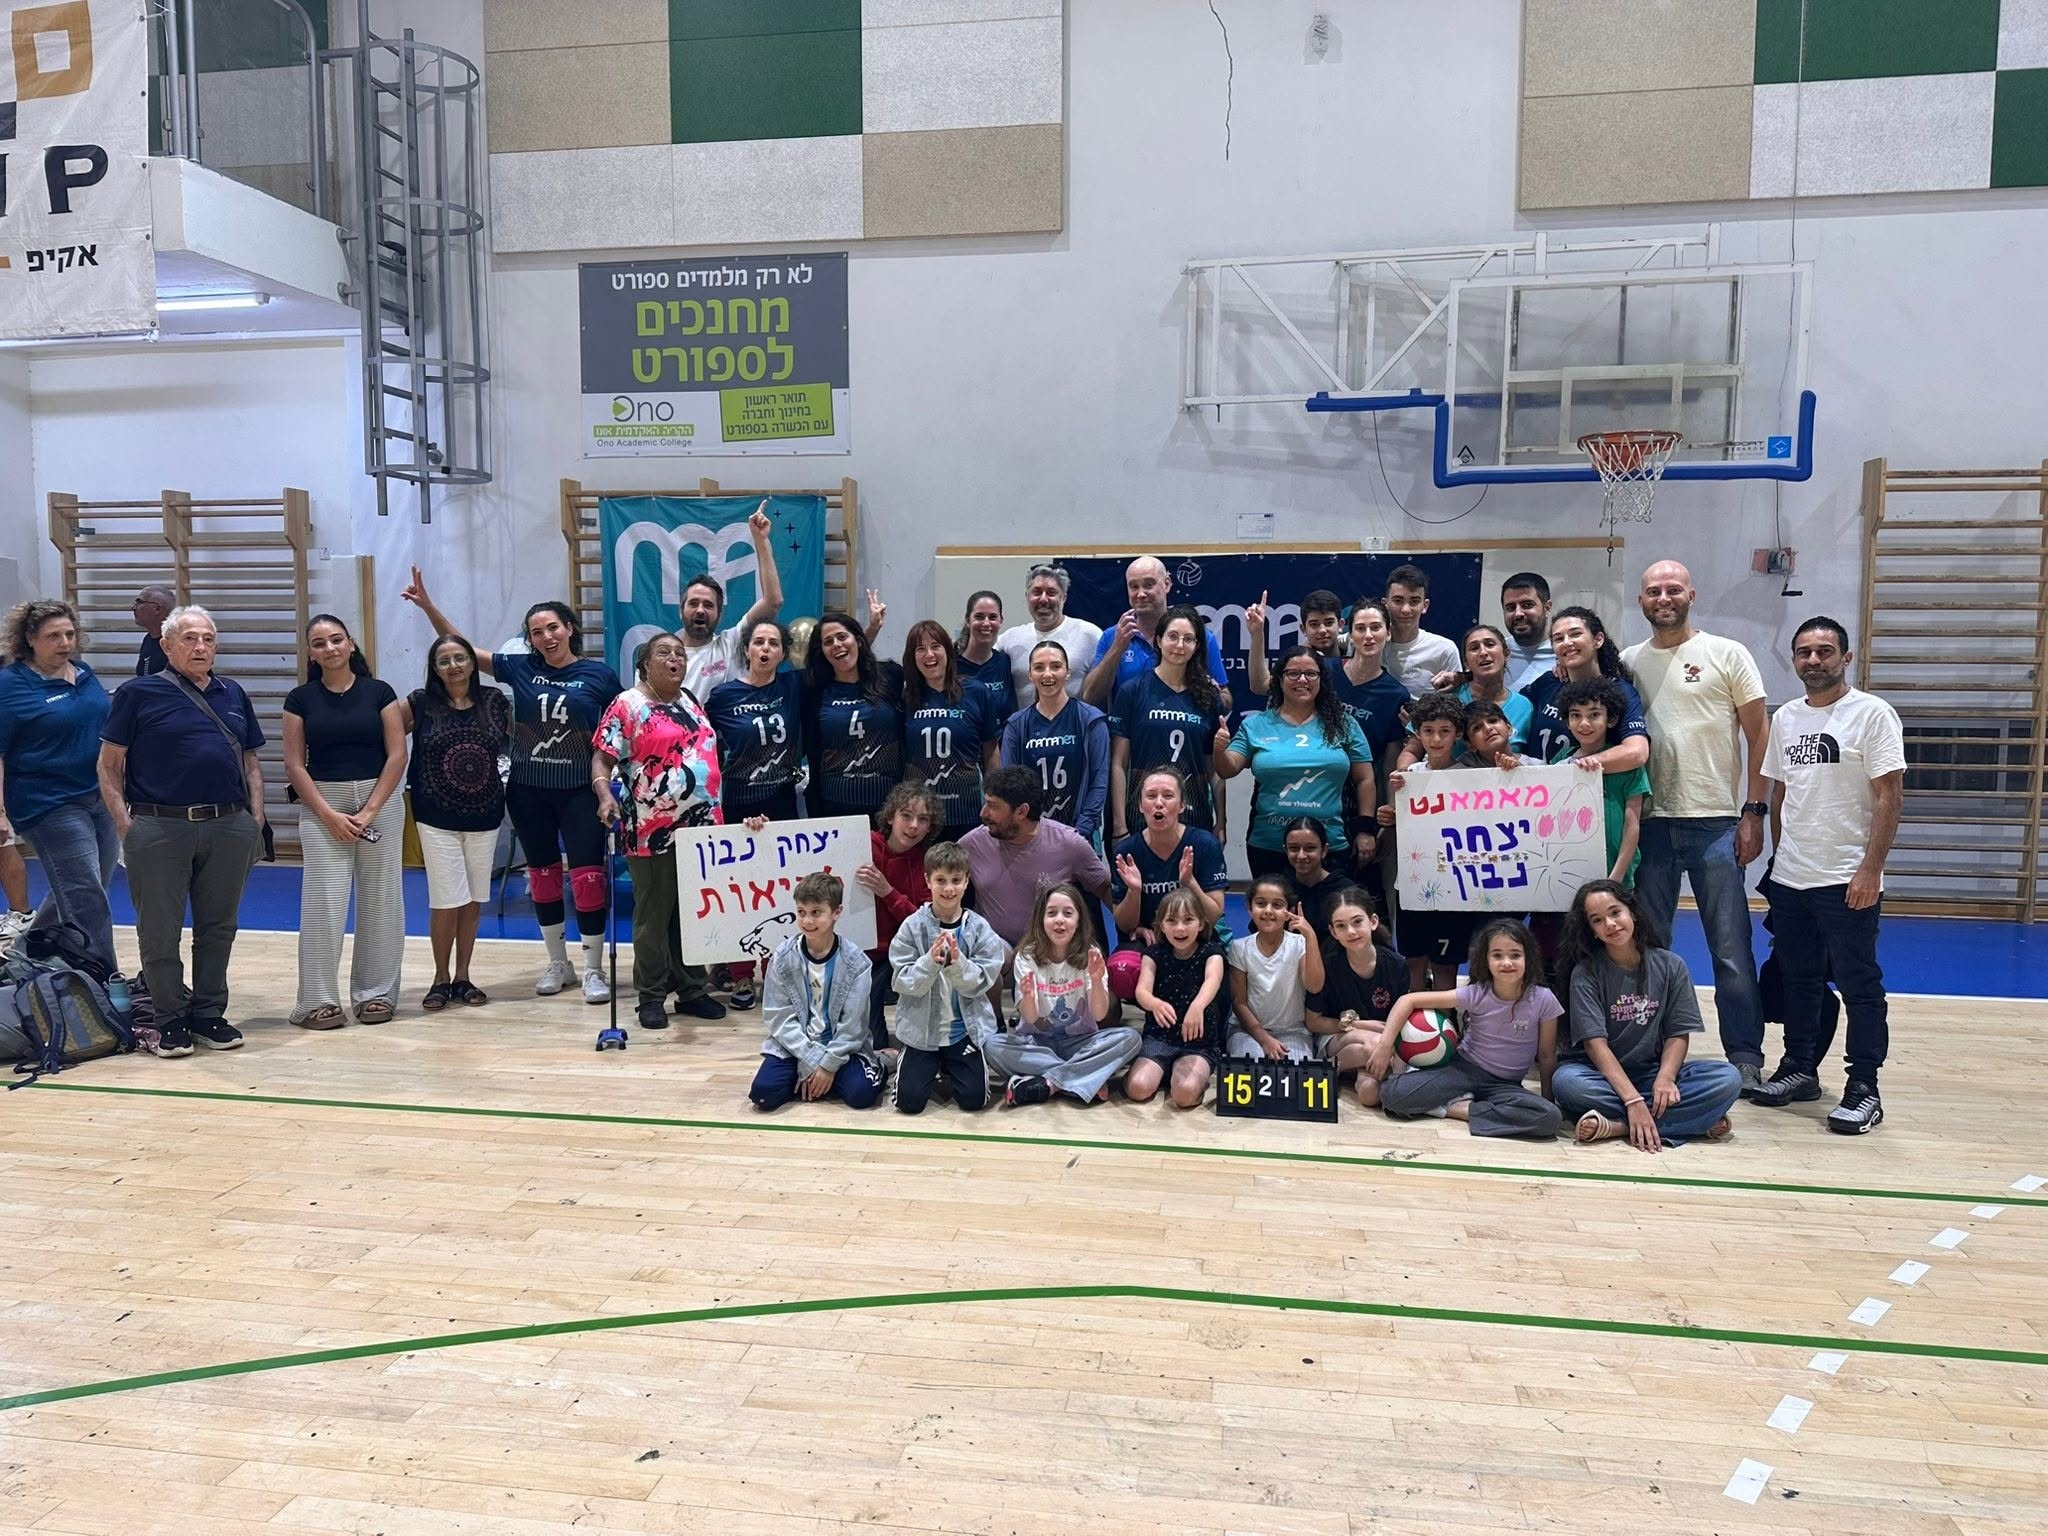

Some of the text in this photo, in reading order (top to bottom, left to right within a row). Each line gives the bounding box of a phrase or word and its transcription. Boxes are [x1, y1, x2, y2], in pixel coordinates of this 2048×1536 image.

[26, 244, 99, 273] אקיפ
[611, 263, 813, 291] לא רק מלמדים ספורט
[636, 297, 790, 337] מחנכים
[631, 336, 794, 383] לספורט
[612, 395, 674, 422] Ono
[742, 405, 811, 420] בחינוך וחברה
[745, 392, 807, 408] תואר ראשון
[615, 426, 660, 437] האקדמית
[662, 425, 692, 436] הקריה
[726, 419, 829, 436] עם הכשרה בספורט
[596, 438, 692, 448] Ono Academic College
[537, 693, 569, 725] 14
[752, 713, 787, 746] 13
[848, 710, 866, 739] 4
[1799, 733, 1820, 745] THE
[921, 726, 952, 759] 10
[1169, 729, 1185, 763] 9
[1295, 733, 1309, 747] 2
[1784, 743, 1818, 756] NORTH
[1036, 755, 1068, 791] 16
[1790, 753, 1817, 766] FACE
[1409, 784, 1549, 816] מאמאנט
[695, 829, 839, 881] יצחק נבון
[1441, 819, 1531, 862] יצחק
[1452, 862, 1529, 901] נבון
[1437, 938, 1450, 956] 7
[1223, 1072, 1329, 1109] 15 2 1 11
